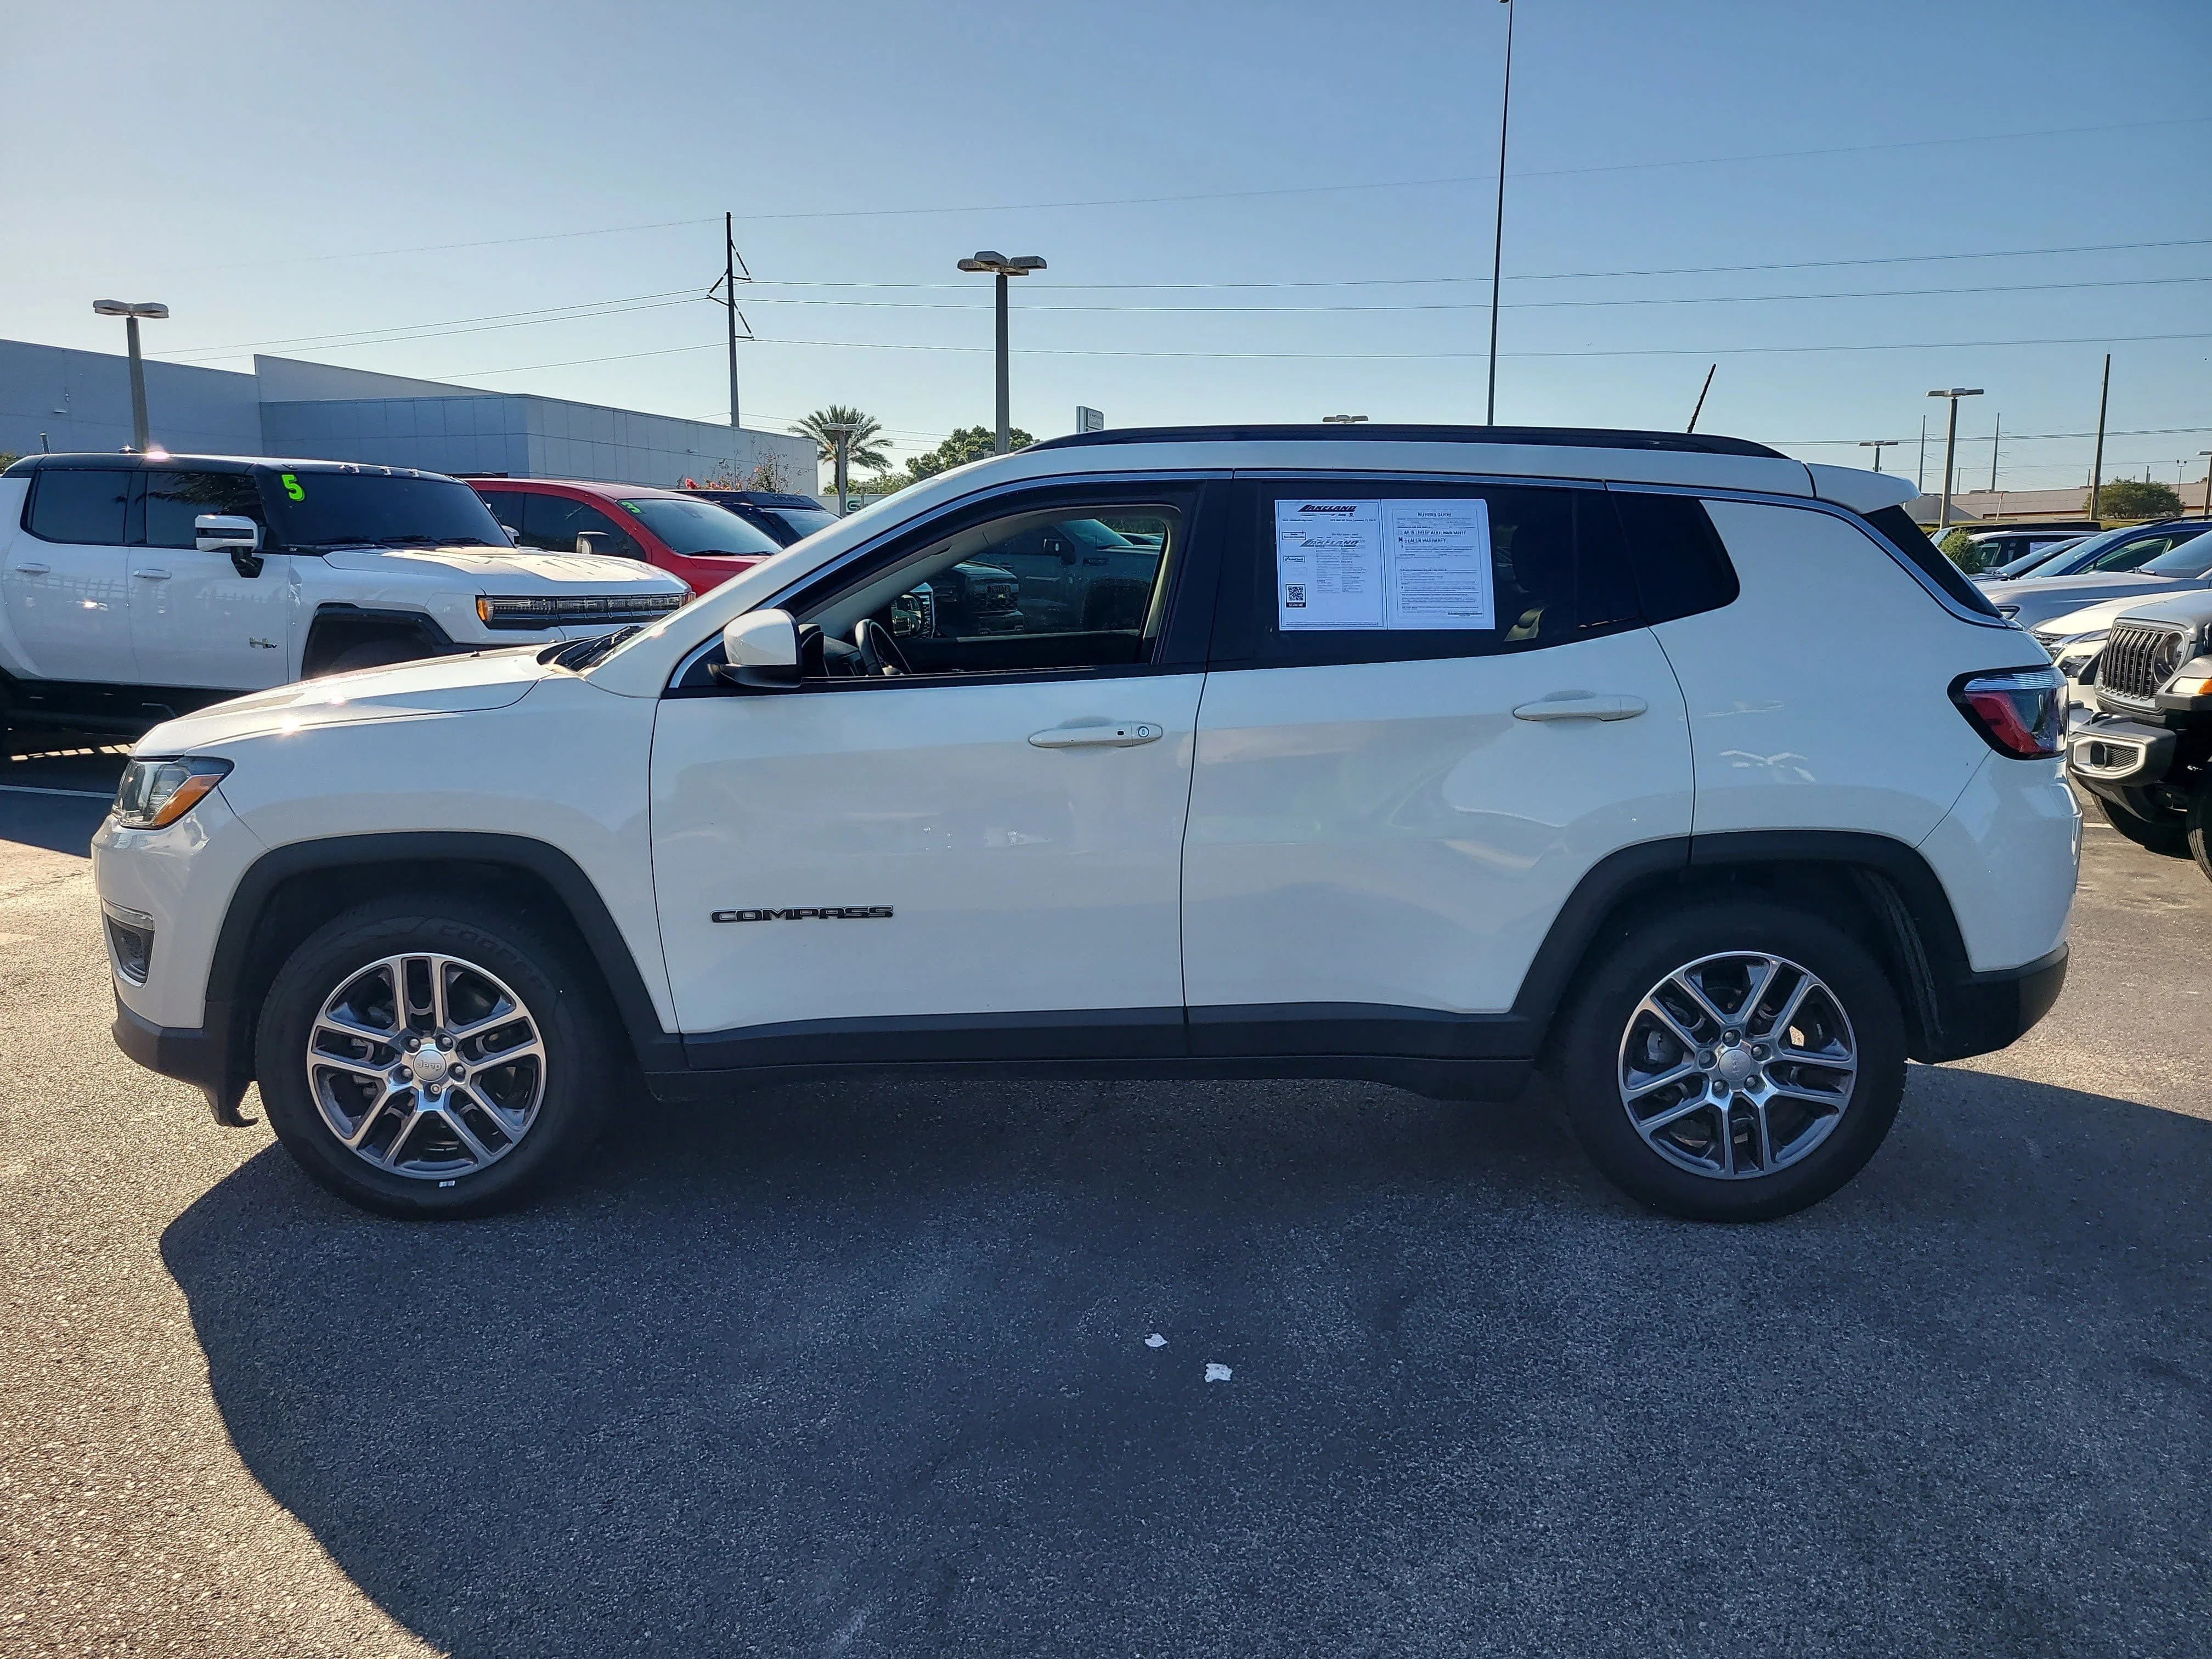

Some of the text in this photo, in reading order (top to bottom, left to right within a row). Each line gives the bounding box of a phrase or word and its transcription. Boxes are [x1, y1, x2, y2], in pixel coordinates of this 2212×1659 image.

[281, 475, 305, 501] 5
[621, 501, 642, 514] 3
[1297, 504, 1357, 512] LAKELAND
[711, 905, 894, 923] COMPASS
[417, 1060, 442, 1072] Jeep
